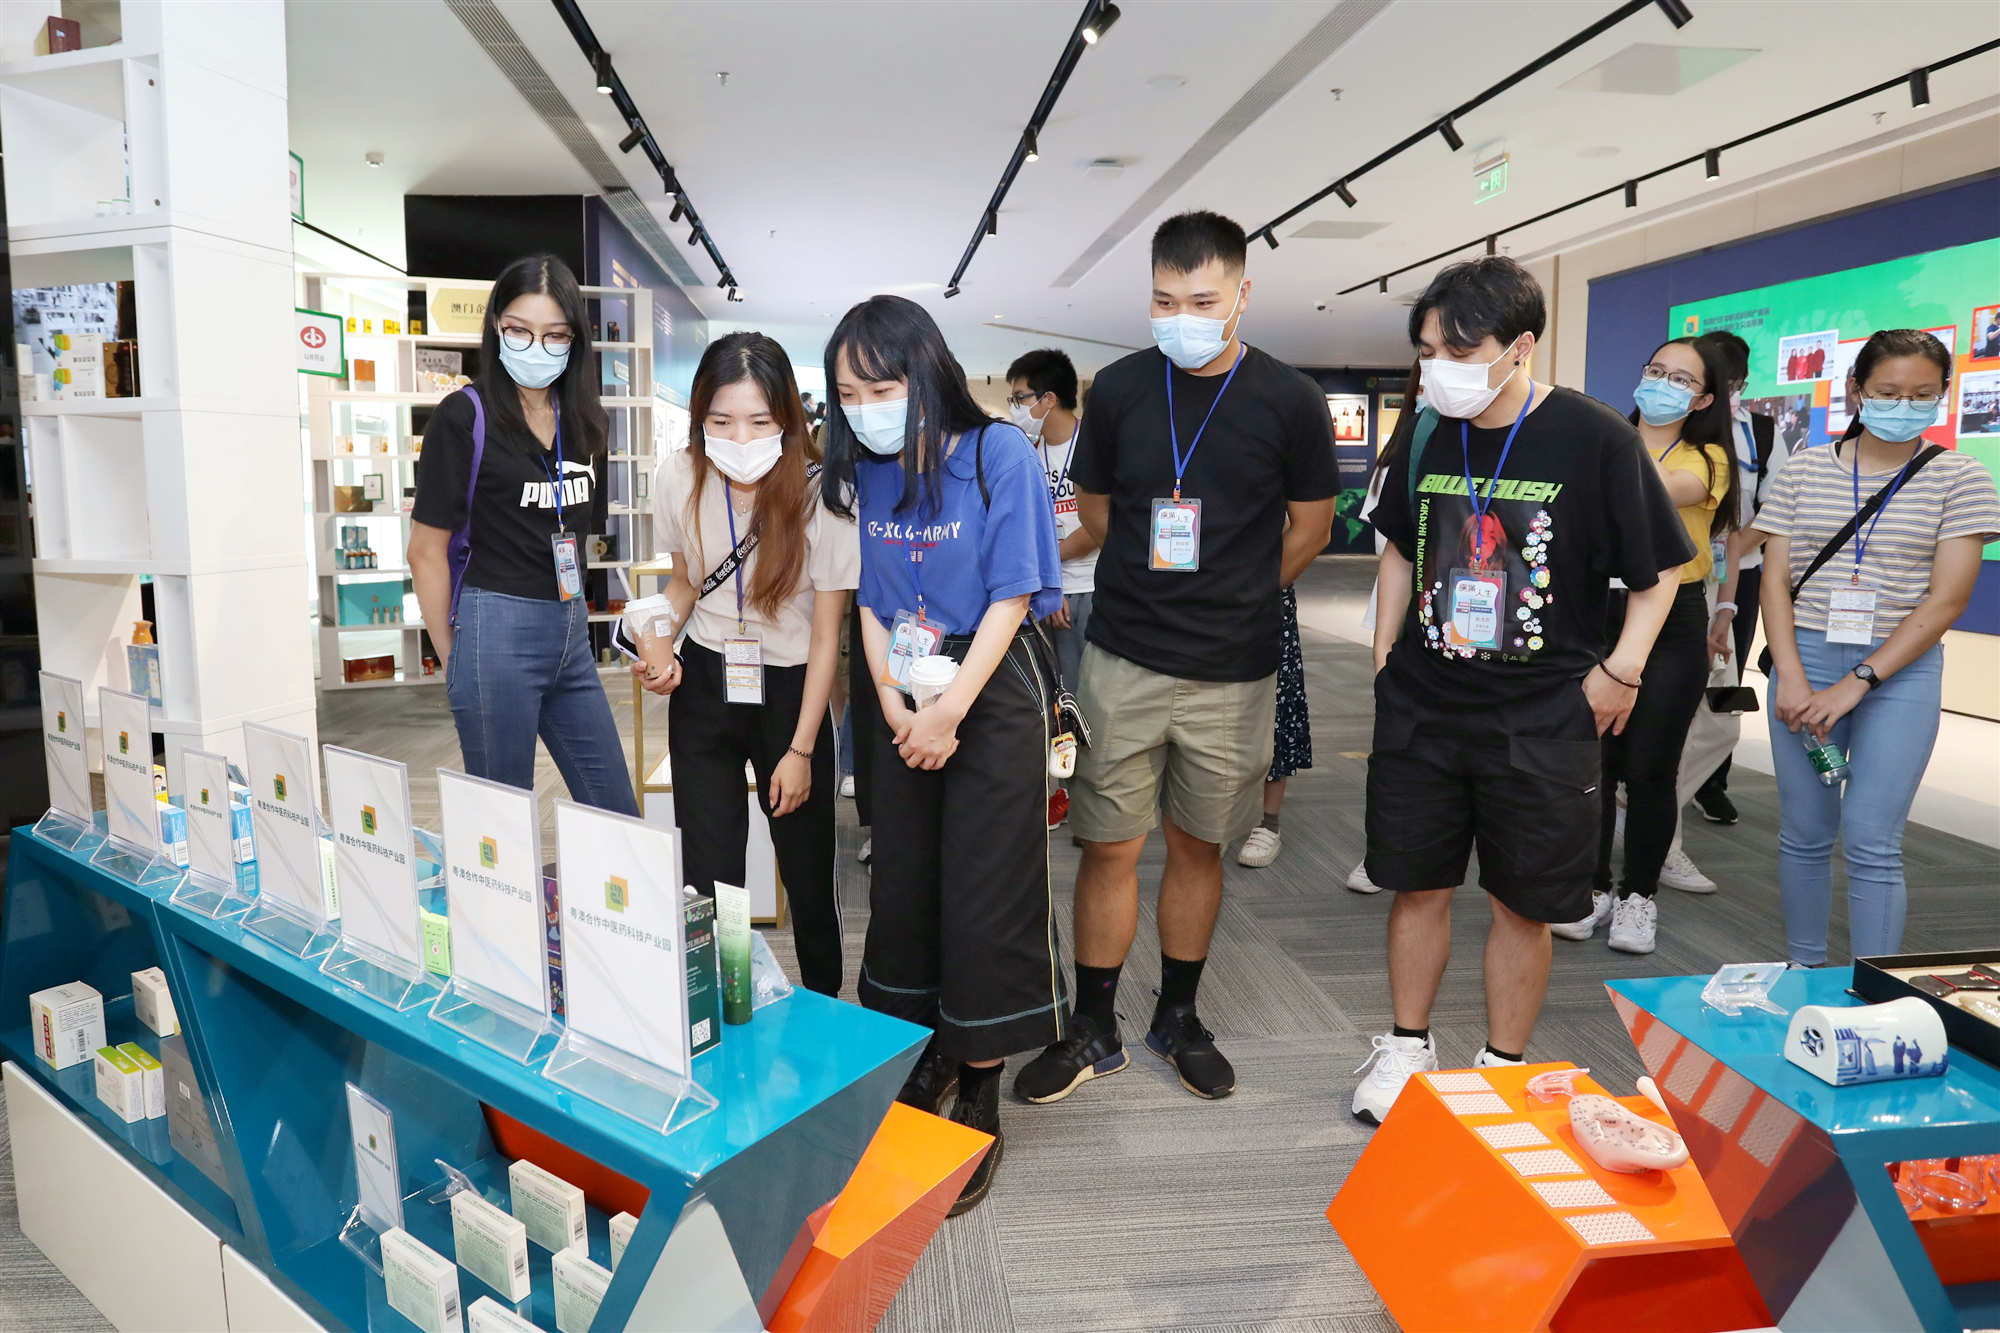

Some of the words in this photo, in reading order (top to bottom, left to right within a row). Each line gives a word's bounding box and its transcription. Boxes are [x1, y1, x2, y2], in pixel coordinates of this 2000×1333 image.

[519, 476, 589, 509] PUMA
[1478, 478, 1564, 503] EILISH
[1418, 498, 1430, 536] TAKASHI
[1416, 538, 1426, 592] MURAKAMI
[339, 832, 406, 865] 粤澳合作中医药科技产业园
[452, 865, 532, 904] 粤澳合作中医药科技产业园
[570, 906, 672, 953] 粤澳合作中医药科技产业园
